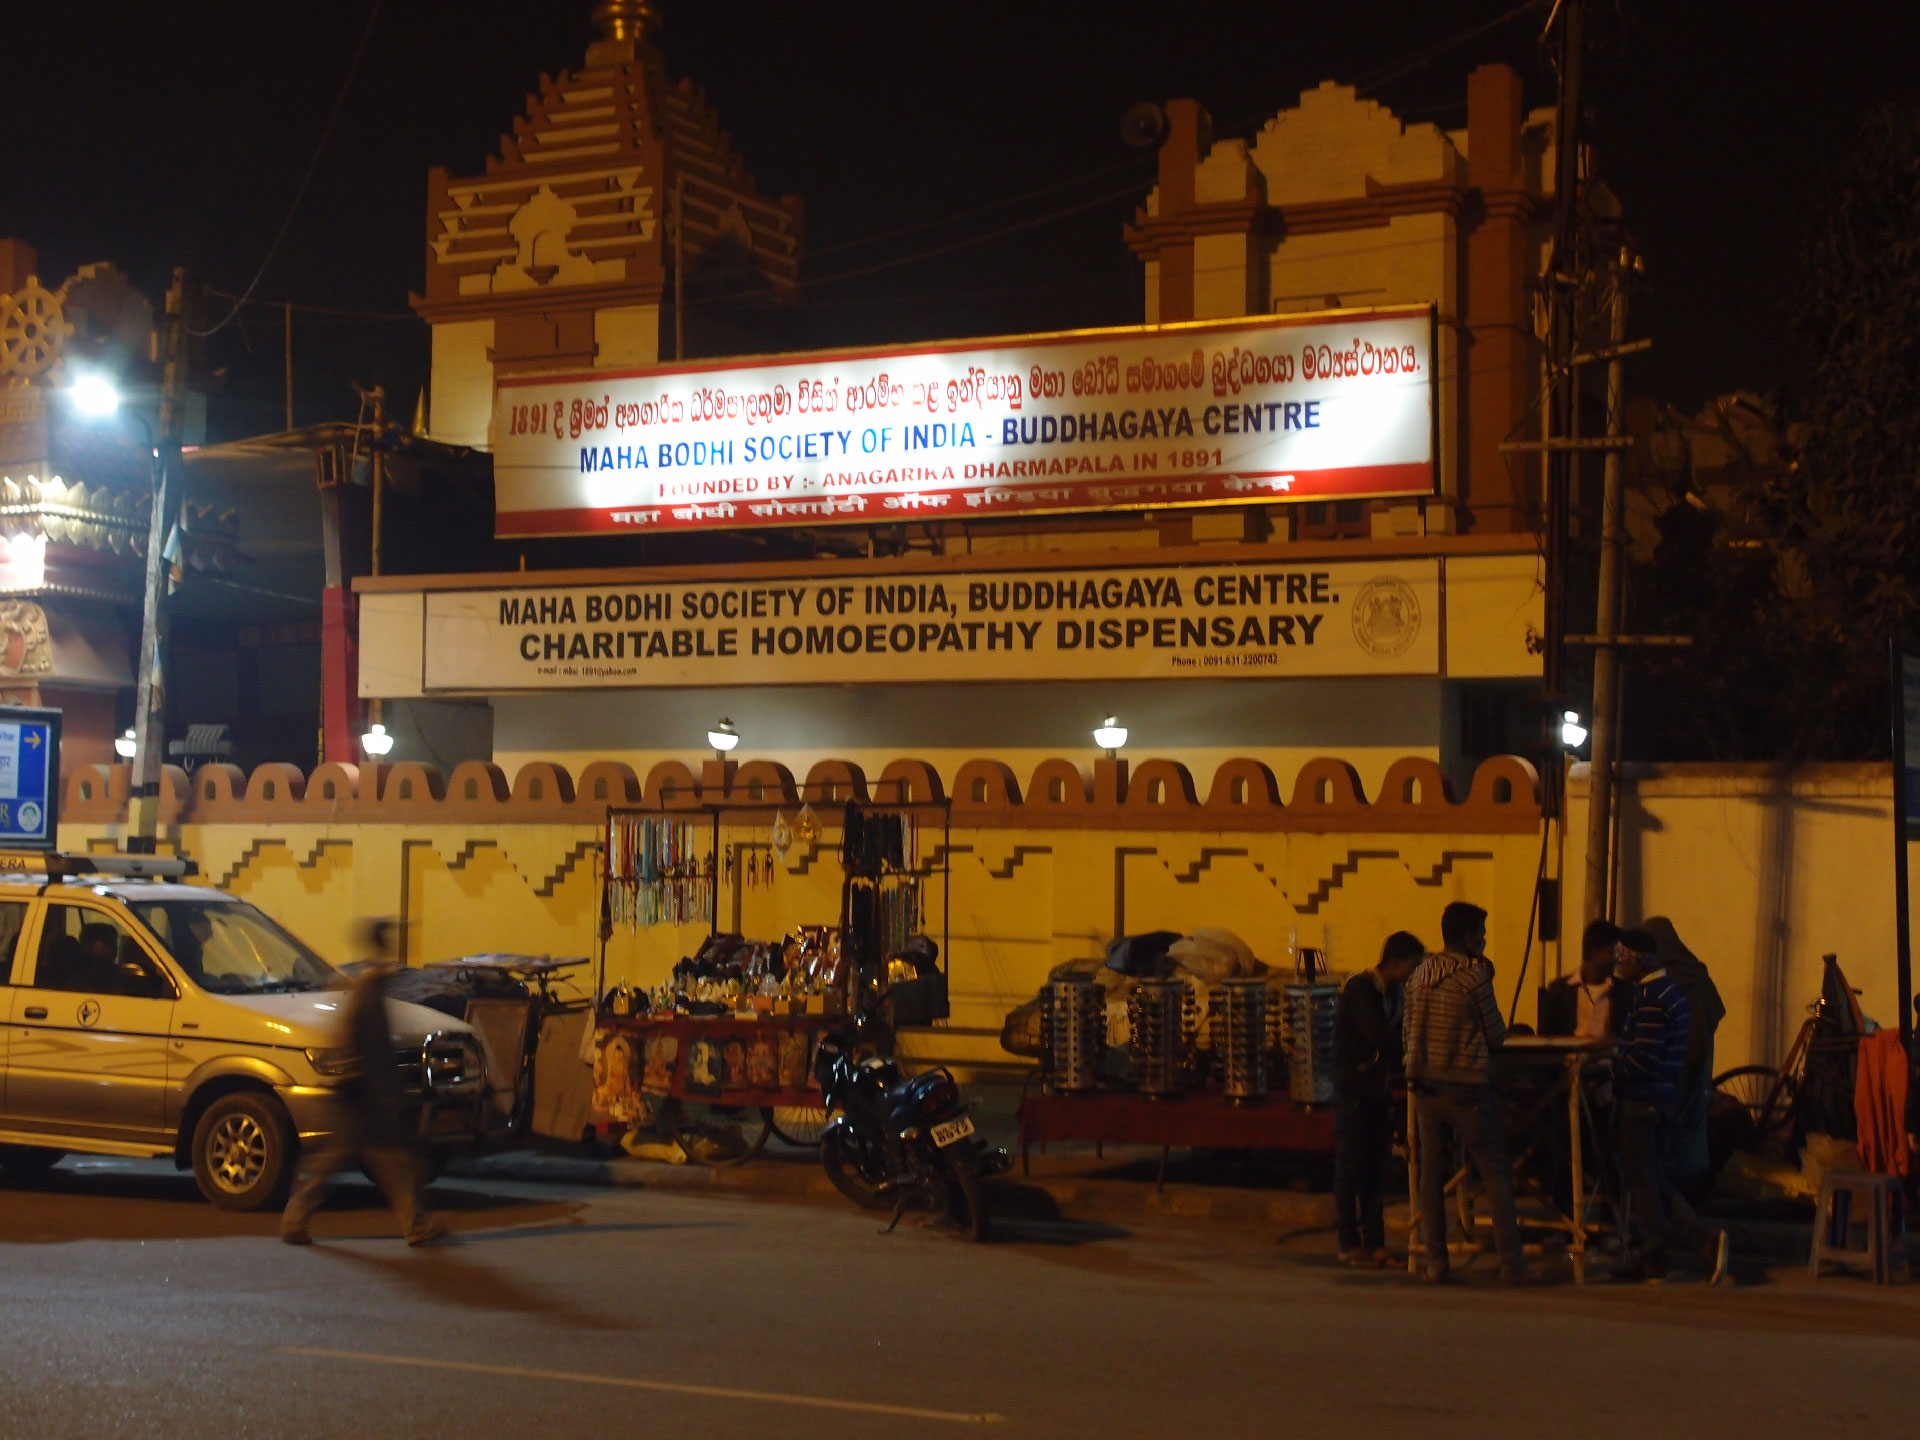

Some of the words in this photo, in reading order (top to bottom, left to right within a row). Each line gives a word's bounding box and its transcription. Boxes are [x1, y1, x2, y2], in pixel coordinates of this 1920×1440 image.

[509, 402, 548, 435] 1891
[1029, 364, 1066, 399] මහා
[580, 444, 649, 473] MAHA
[658, 440, 733, 468] BODHI
[743, 430, 852, 463] SOCIETY
[861, 427, 893, 453] OF
[904, 422, 976, 451] INDIA
[1002, 406, 1194, 446] BUDDHAGAYA
[1203, 400, 1321, 435] CENTRE
[659, 477, 759, 498] FOUNDED
[767, 474, 795, 491] BY
[822, 465, 955, 488] ANAGARIKA
[964, 453, 1125, 479] DHARMAPALA
[1133, 452, 1158, 471] IN
[1168, 448, 1222, 469] 1891
[499, 596, 577, 626] MAHA
[586, 592, 672, 623] BODHI
[682, 587, 807, 620] SOCIETY
[816, 586, 855, 616] OF
[865, 583, 957, 618] INDIA,
[968, 576, 1183, 612] BUDDHAGAYA
[1193, 572, 1340, 607] CENTRE.
[520, 628, 738, 661] CHARITABLE
[751, 619, 1043, 655] HOMOEOPATHY
[1056, 613, 1324, 649] DISPENSARY
[1171, 655, 1197, 667] Phone
